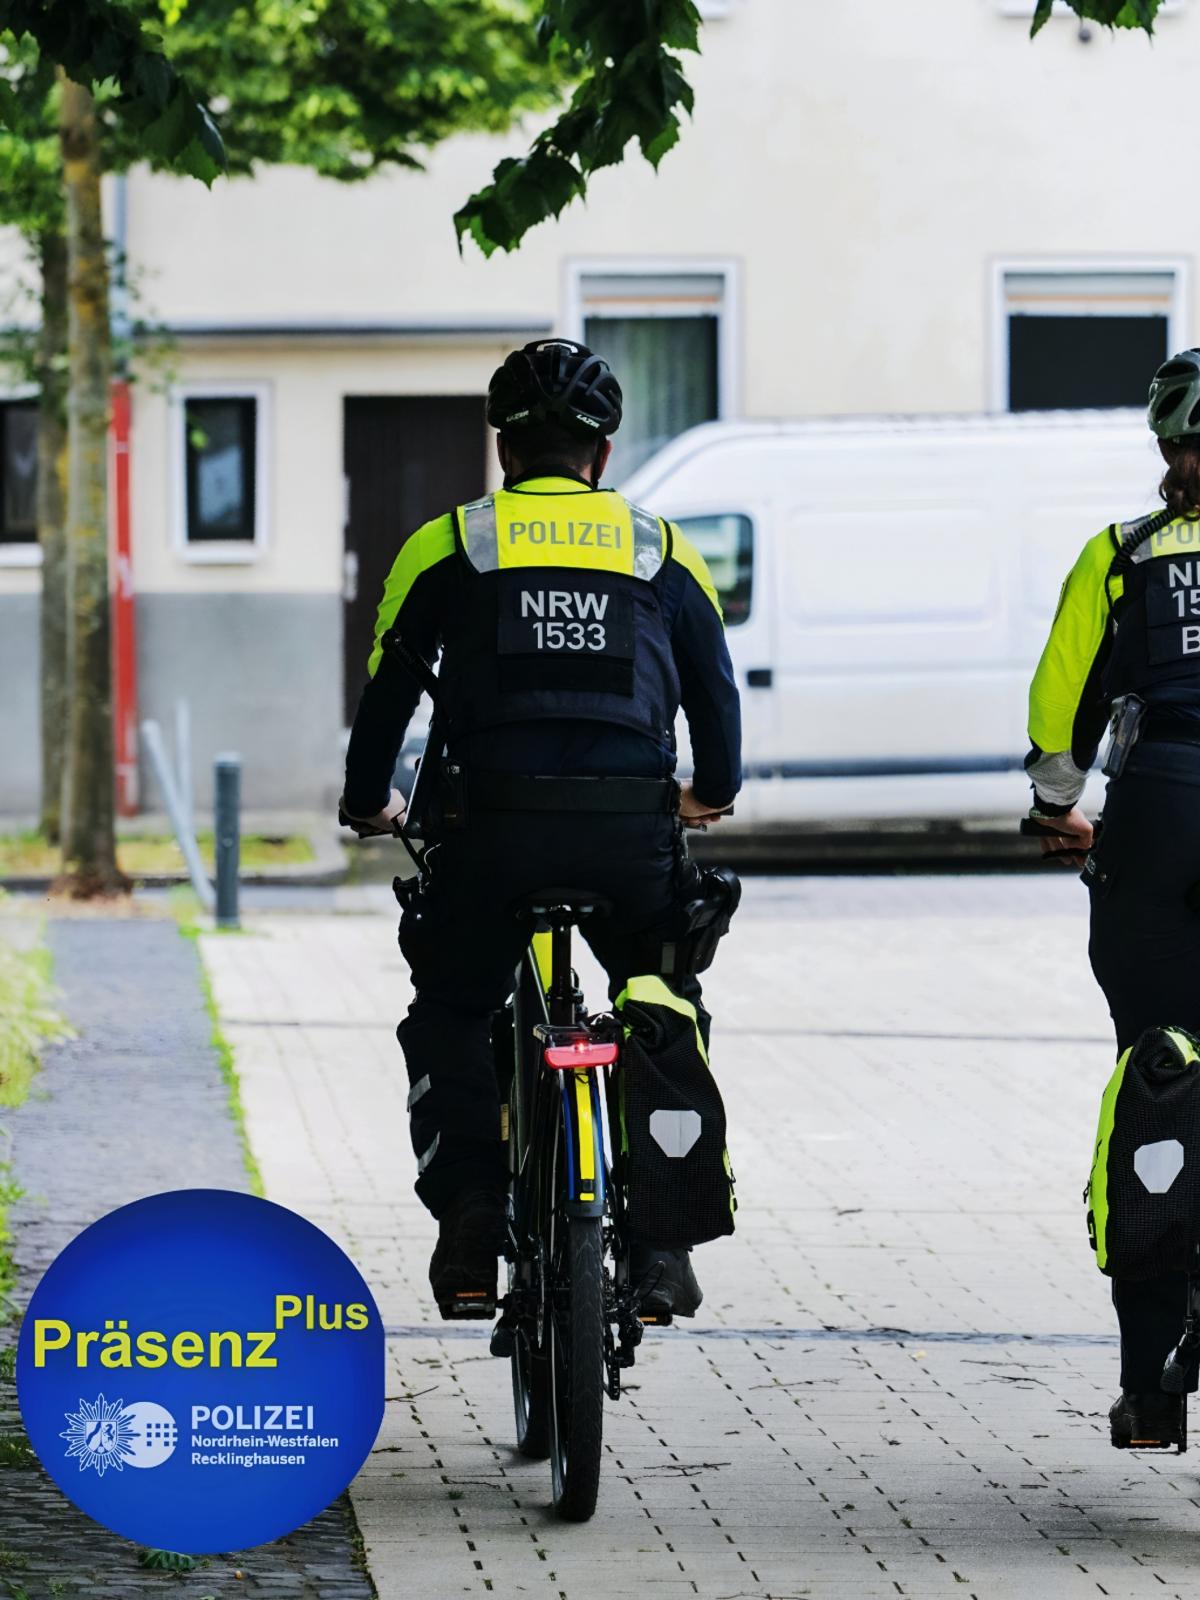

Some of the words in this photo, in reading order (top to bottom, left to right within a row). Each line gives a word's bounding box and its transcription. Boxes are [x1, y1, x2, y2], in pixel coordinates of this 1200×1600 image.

[576, 414, 601, 429] LAZER
[509, 520, 622, 549] POLIZEI
[520, 590, 609, 620] NRW
[532, 621, 606, 651] 1533
